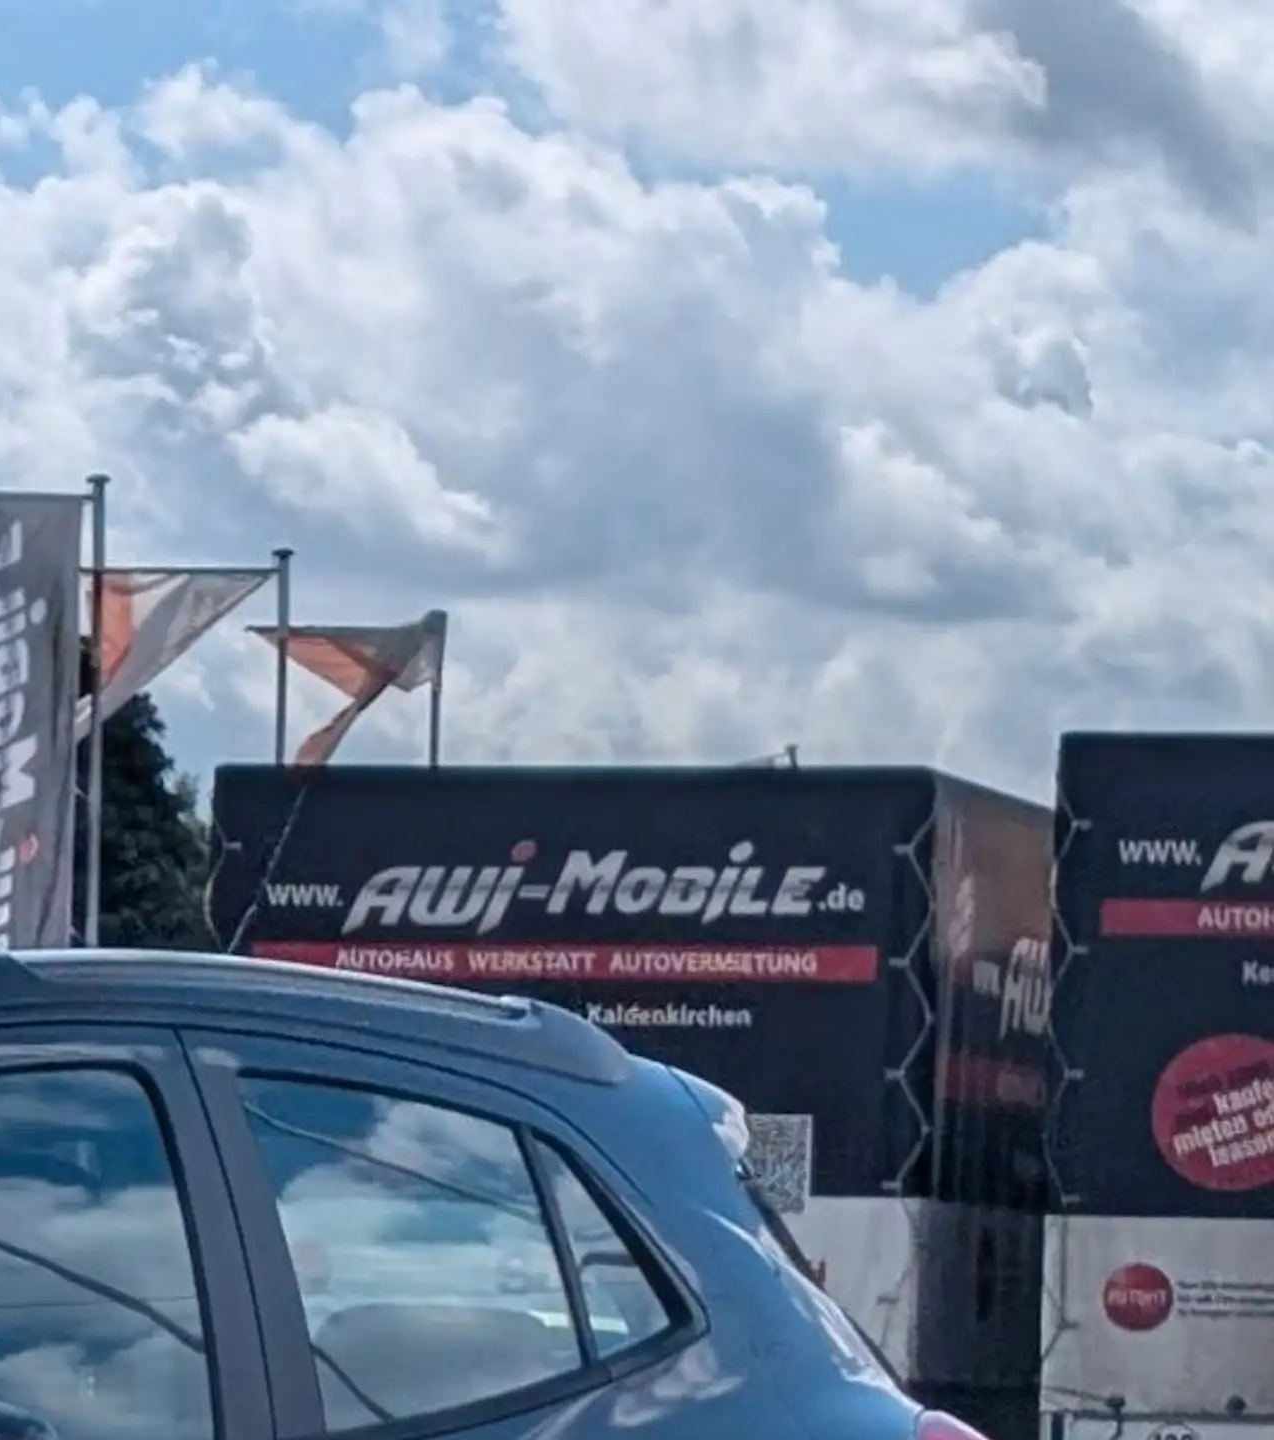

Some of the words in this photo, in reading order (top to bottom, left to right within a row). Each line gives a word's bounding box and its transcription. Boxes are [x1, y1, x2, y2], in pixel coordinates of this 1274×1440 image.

[336, 946, 455, 972] AUTOHAUS
[466, 948, 595, 973] WERKSTATT
[609, 950, 818, 975] AUTOVERMIETUNG
[585, 1002, 754, 1028] Kaldenkirchen
